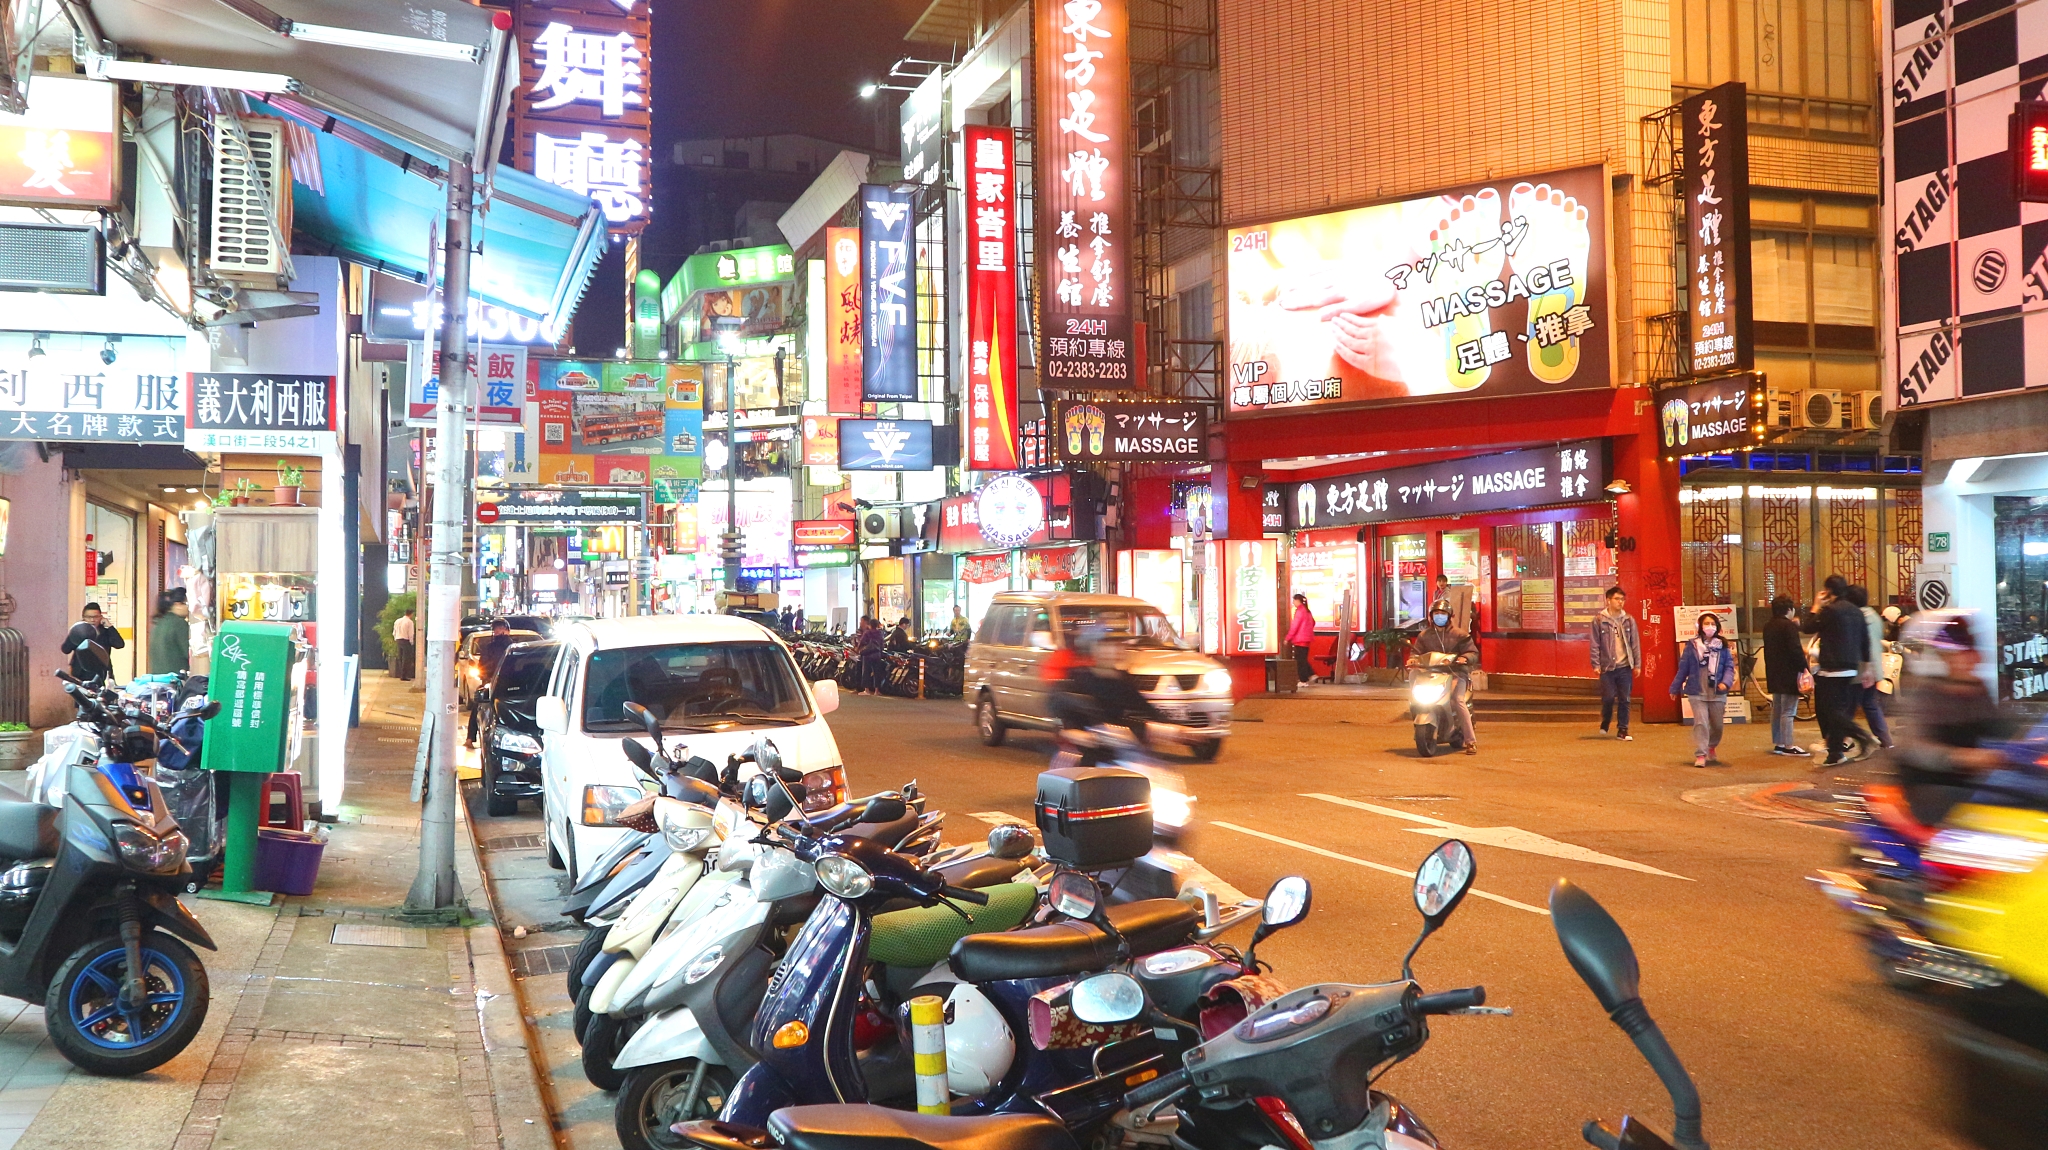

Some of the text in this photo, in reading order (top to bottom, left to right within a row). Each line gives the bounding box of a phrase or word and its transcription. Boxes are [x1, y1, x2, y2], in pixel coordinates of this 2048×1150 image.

[1894, 10, 1955, 107] STAGE
[1697, 100, 1723, 246] 東方足體
[974, 138, 1006, 272] 皇家峇里
[1896, 168, 1959, 254] STAGE
[1233, 231, 1268, 254] 24H
[1385, 215, 1530, 291] マッサージ
[1055, 210, 1084, 306] 養生館
[1421, 258, 1575, 328] MASSAGE
[1066, 318, 1107, 336] 24H
[1703, 322, 1724, 337] 24H
[1049, 337, 1126, 359] 預約專線
[1694, 338, 1734, 356] 預約專線
[1049, 360, 1127, 380] 02-2383-2283
[1234, 362, 1268, 385] VIP
[1694, 353, 1735, 371] 02-2383-2283
[1899, 317, 1962, 407] STAGE
[197, 377, 326, 427] 義大利西服
[1234, 378, 1342, 407] 專屬個人包廂
[1690, 391, 1746, 416] マッサージ
[10, 411, 177, 438] 大名牌款式
[1114, 411, 1198, 432] マッサージ
[1691, 418, 1747, 440] MASSAGE
[203, 433, 317, 449] 漢口街二段54之1
[1114, 437, 1199, 454] MASSAGE
[1398, 474, 1465, 504] マッサージ
[1472, 467, 1546, 496] MASSAGE
[1561, 473, 1590, 499] 推拿
[1326, 479, 1389, 516] 東方足體
[986, 524, 1035, 542] MASSAGE
[1620, 536, 1636, 552] 80
[1935, 536, 1947, 548] 78
[1238, 567, 1265, 651] 按摩名店
